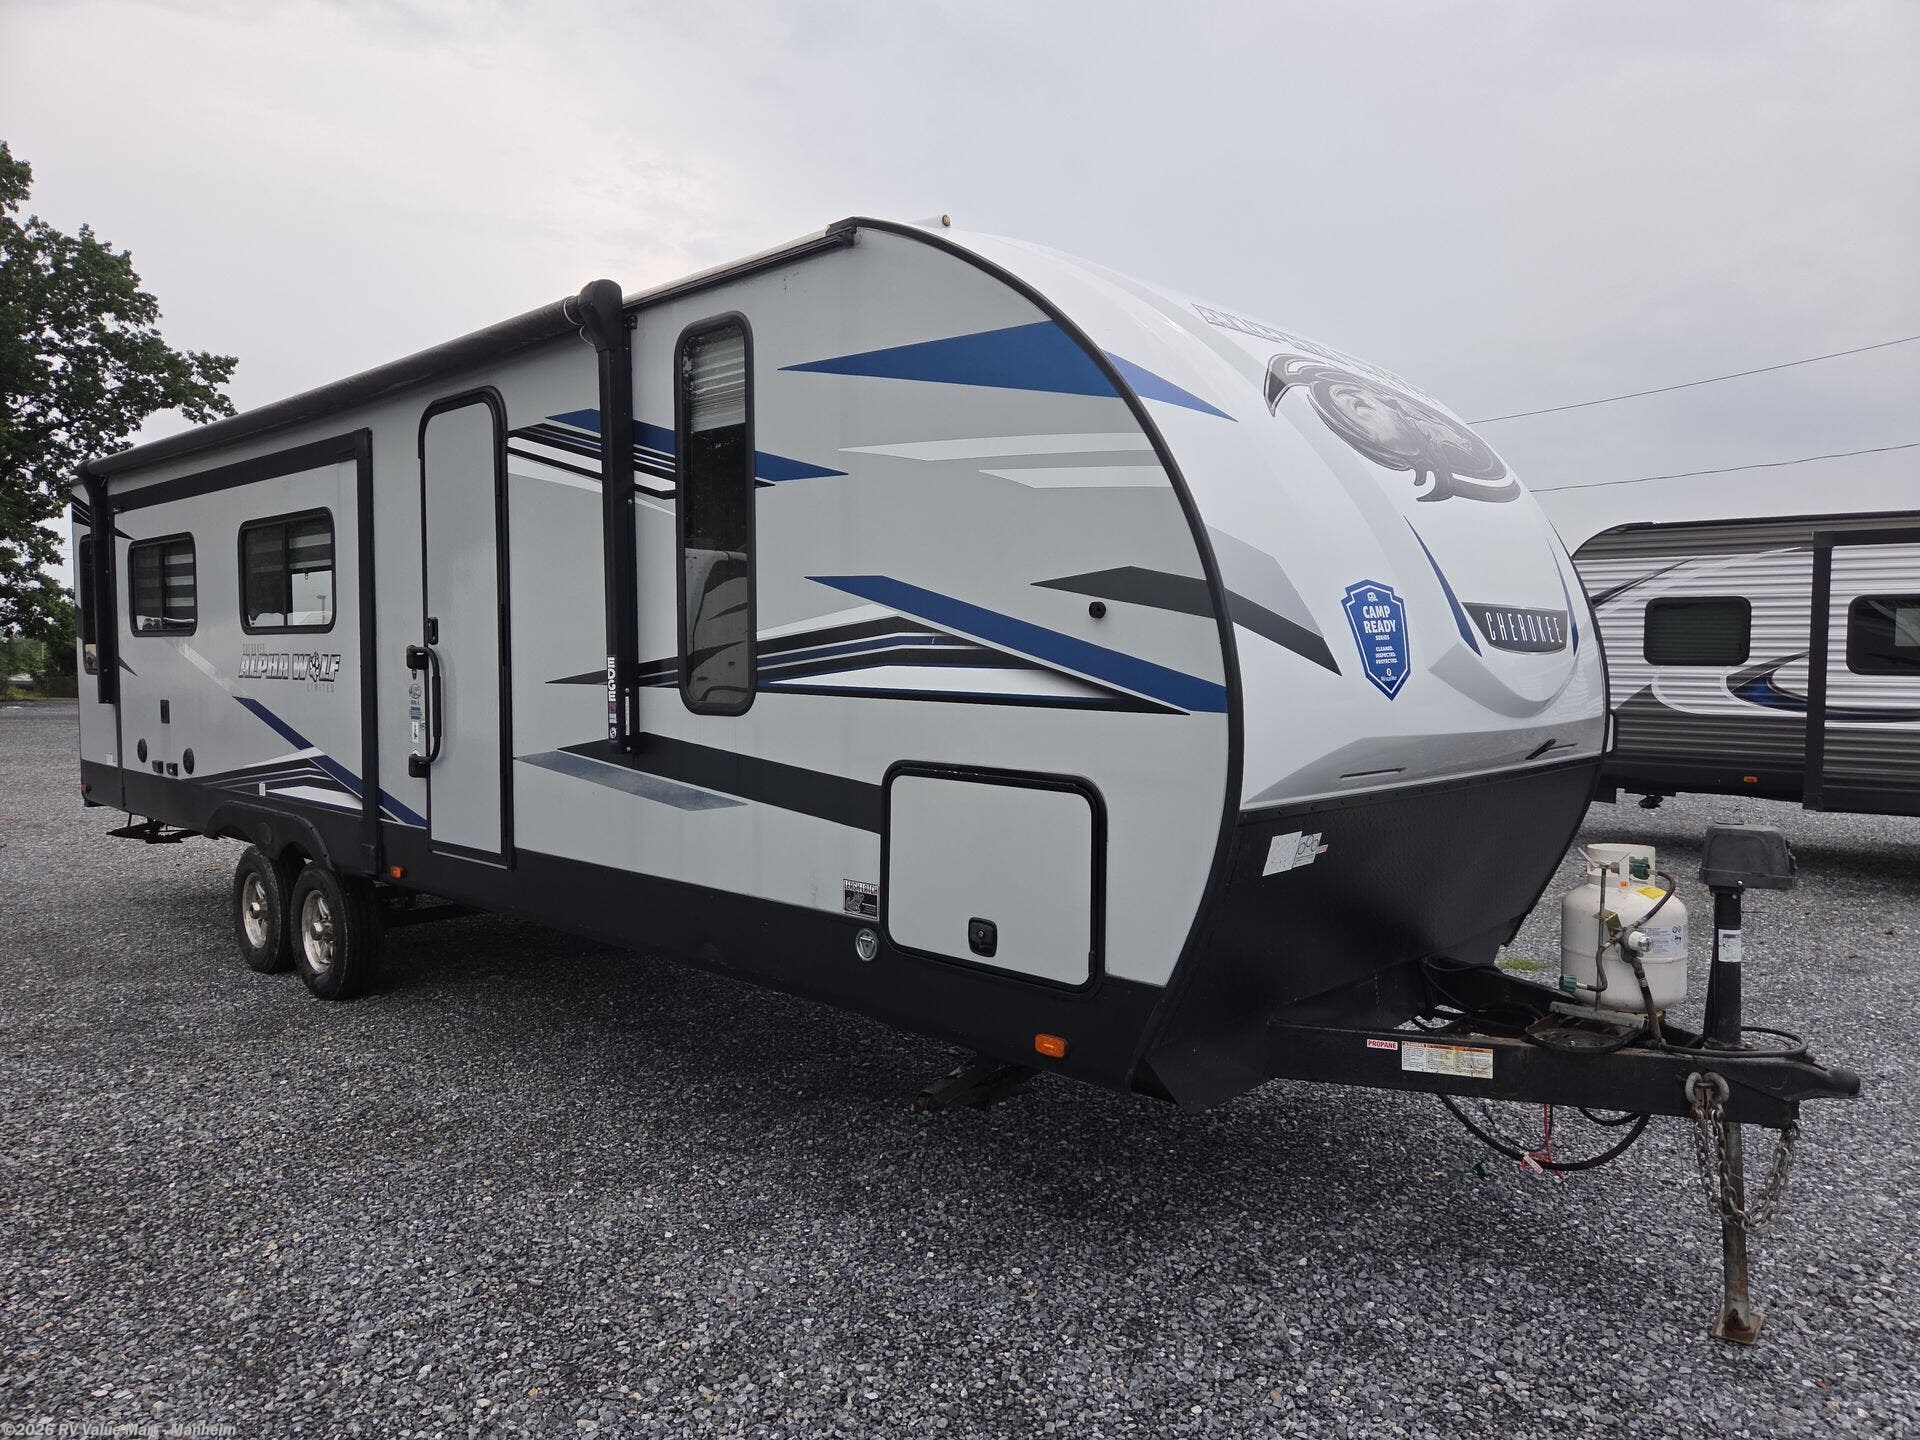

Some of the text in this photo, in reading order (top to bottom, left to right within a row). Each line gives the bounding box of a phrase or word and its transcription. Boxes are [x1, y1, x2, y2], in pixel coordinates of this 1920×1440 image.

[1362, 605, 1391, 619] CAMP
[1363, 619, 1396, 634] READY
[1485, 612, 1563, 643] CHEROKEE
[238, 653, 290, 680] ALPHA
[607, 656, 617, 702] EDGE
[1367, 1040, 1397, 1049] PROPANE
